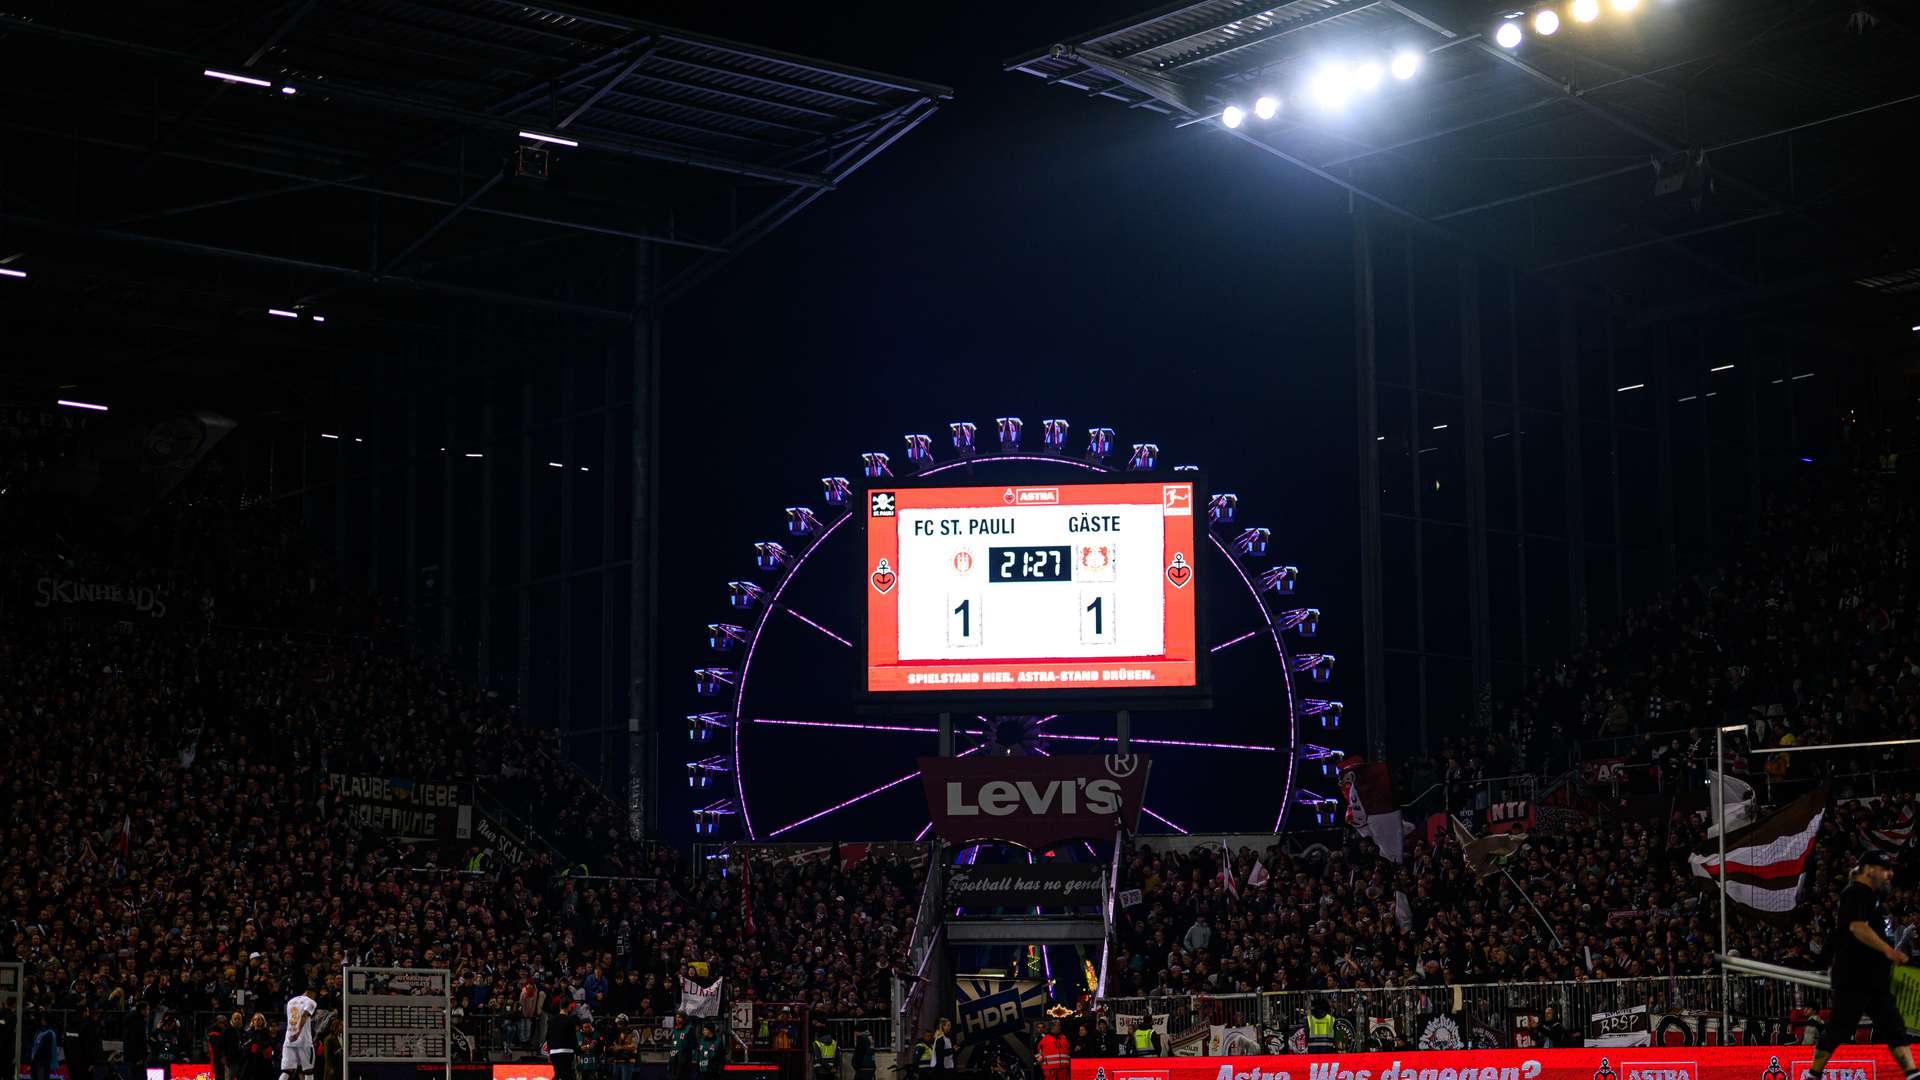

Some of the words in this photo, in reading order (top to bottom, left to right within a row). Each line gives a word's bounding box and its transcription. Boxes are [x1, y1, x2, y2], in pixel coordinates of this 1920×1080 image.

[1020, 491, 1056, 501] ASTRA
[914, 520, 934, 536] FC
[940, 519, 962, 536] ST.
[969, 518, 1015, 535] PAULI
[1069, 513, 1121, 533] GÄSTE
[1000, 551, 1061, 578] 21:27
[34, 577, 167, 618] SKINHEADS
[954, 600, 969, 637] 1
[1087, 597, 1102, 634] 1
[907, 673, 979, 684] SPIELSTAND
[982, 672, 1014, 683] HIER.
[1017, 670, 1099, 682] ASTRA-STAND
[1102, 668, 1155, 680] DRÜBEN.
[1014, 877, 1041, 891] has
[1043, 881, 1062, 891] no
[965, 1001, 1019, 1034] HDR
[1800, 1068, 1867, 1080] ATRA
